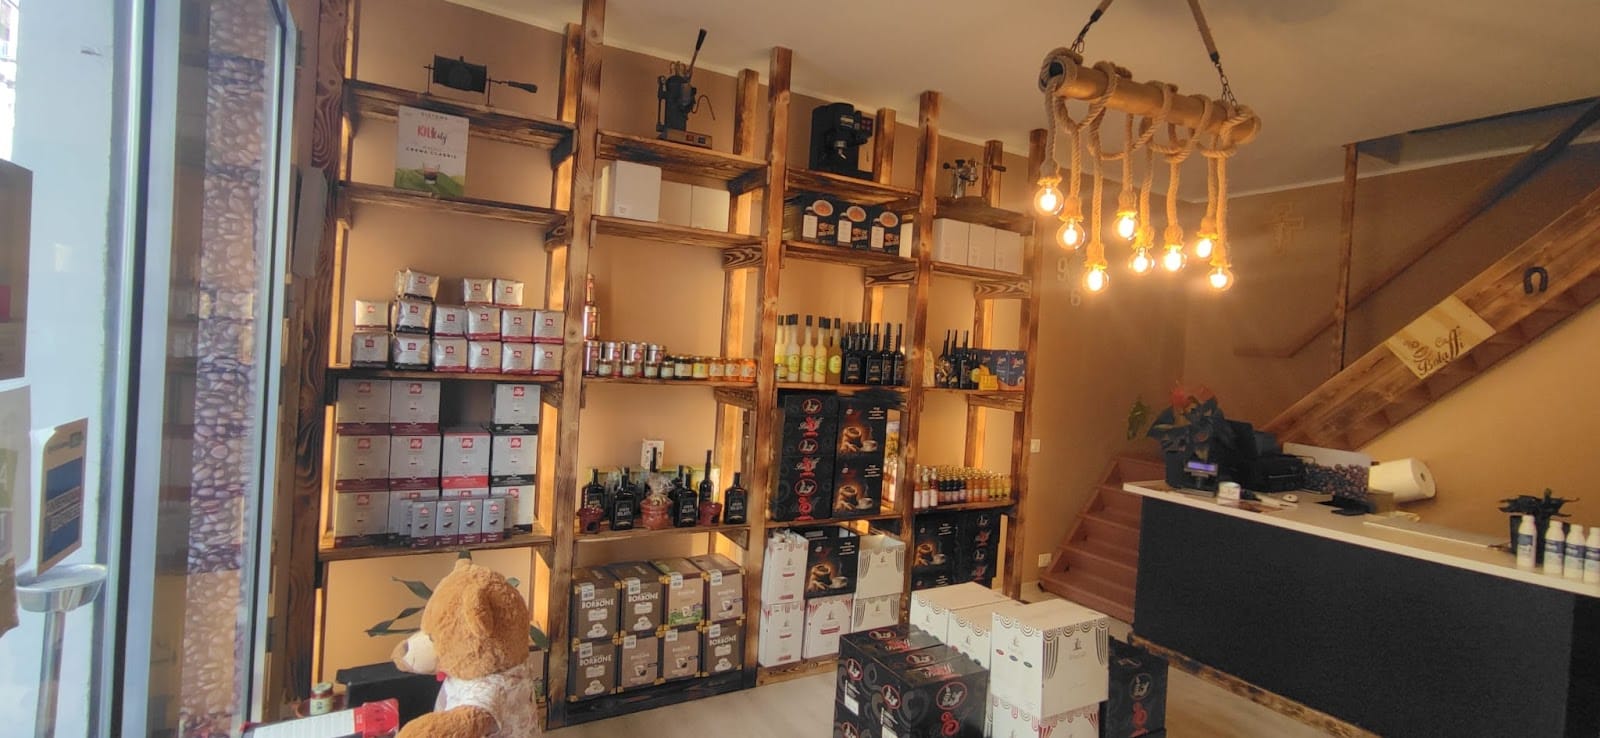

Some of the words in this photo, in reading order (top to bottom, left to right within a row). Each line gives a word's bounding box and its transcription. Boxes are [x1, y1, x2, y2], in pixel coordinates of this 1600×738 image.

[628, 592, 659, 603] BORBONE
[581, 599, 615, 609] BORBONE
[709, 634, 737, 647] BORBONE
[579, 654, 612, 666] BORBONE
